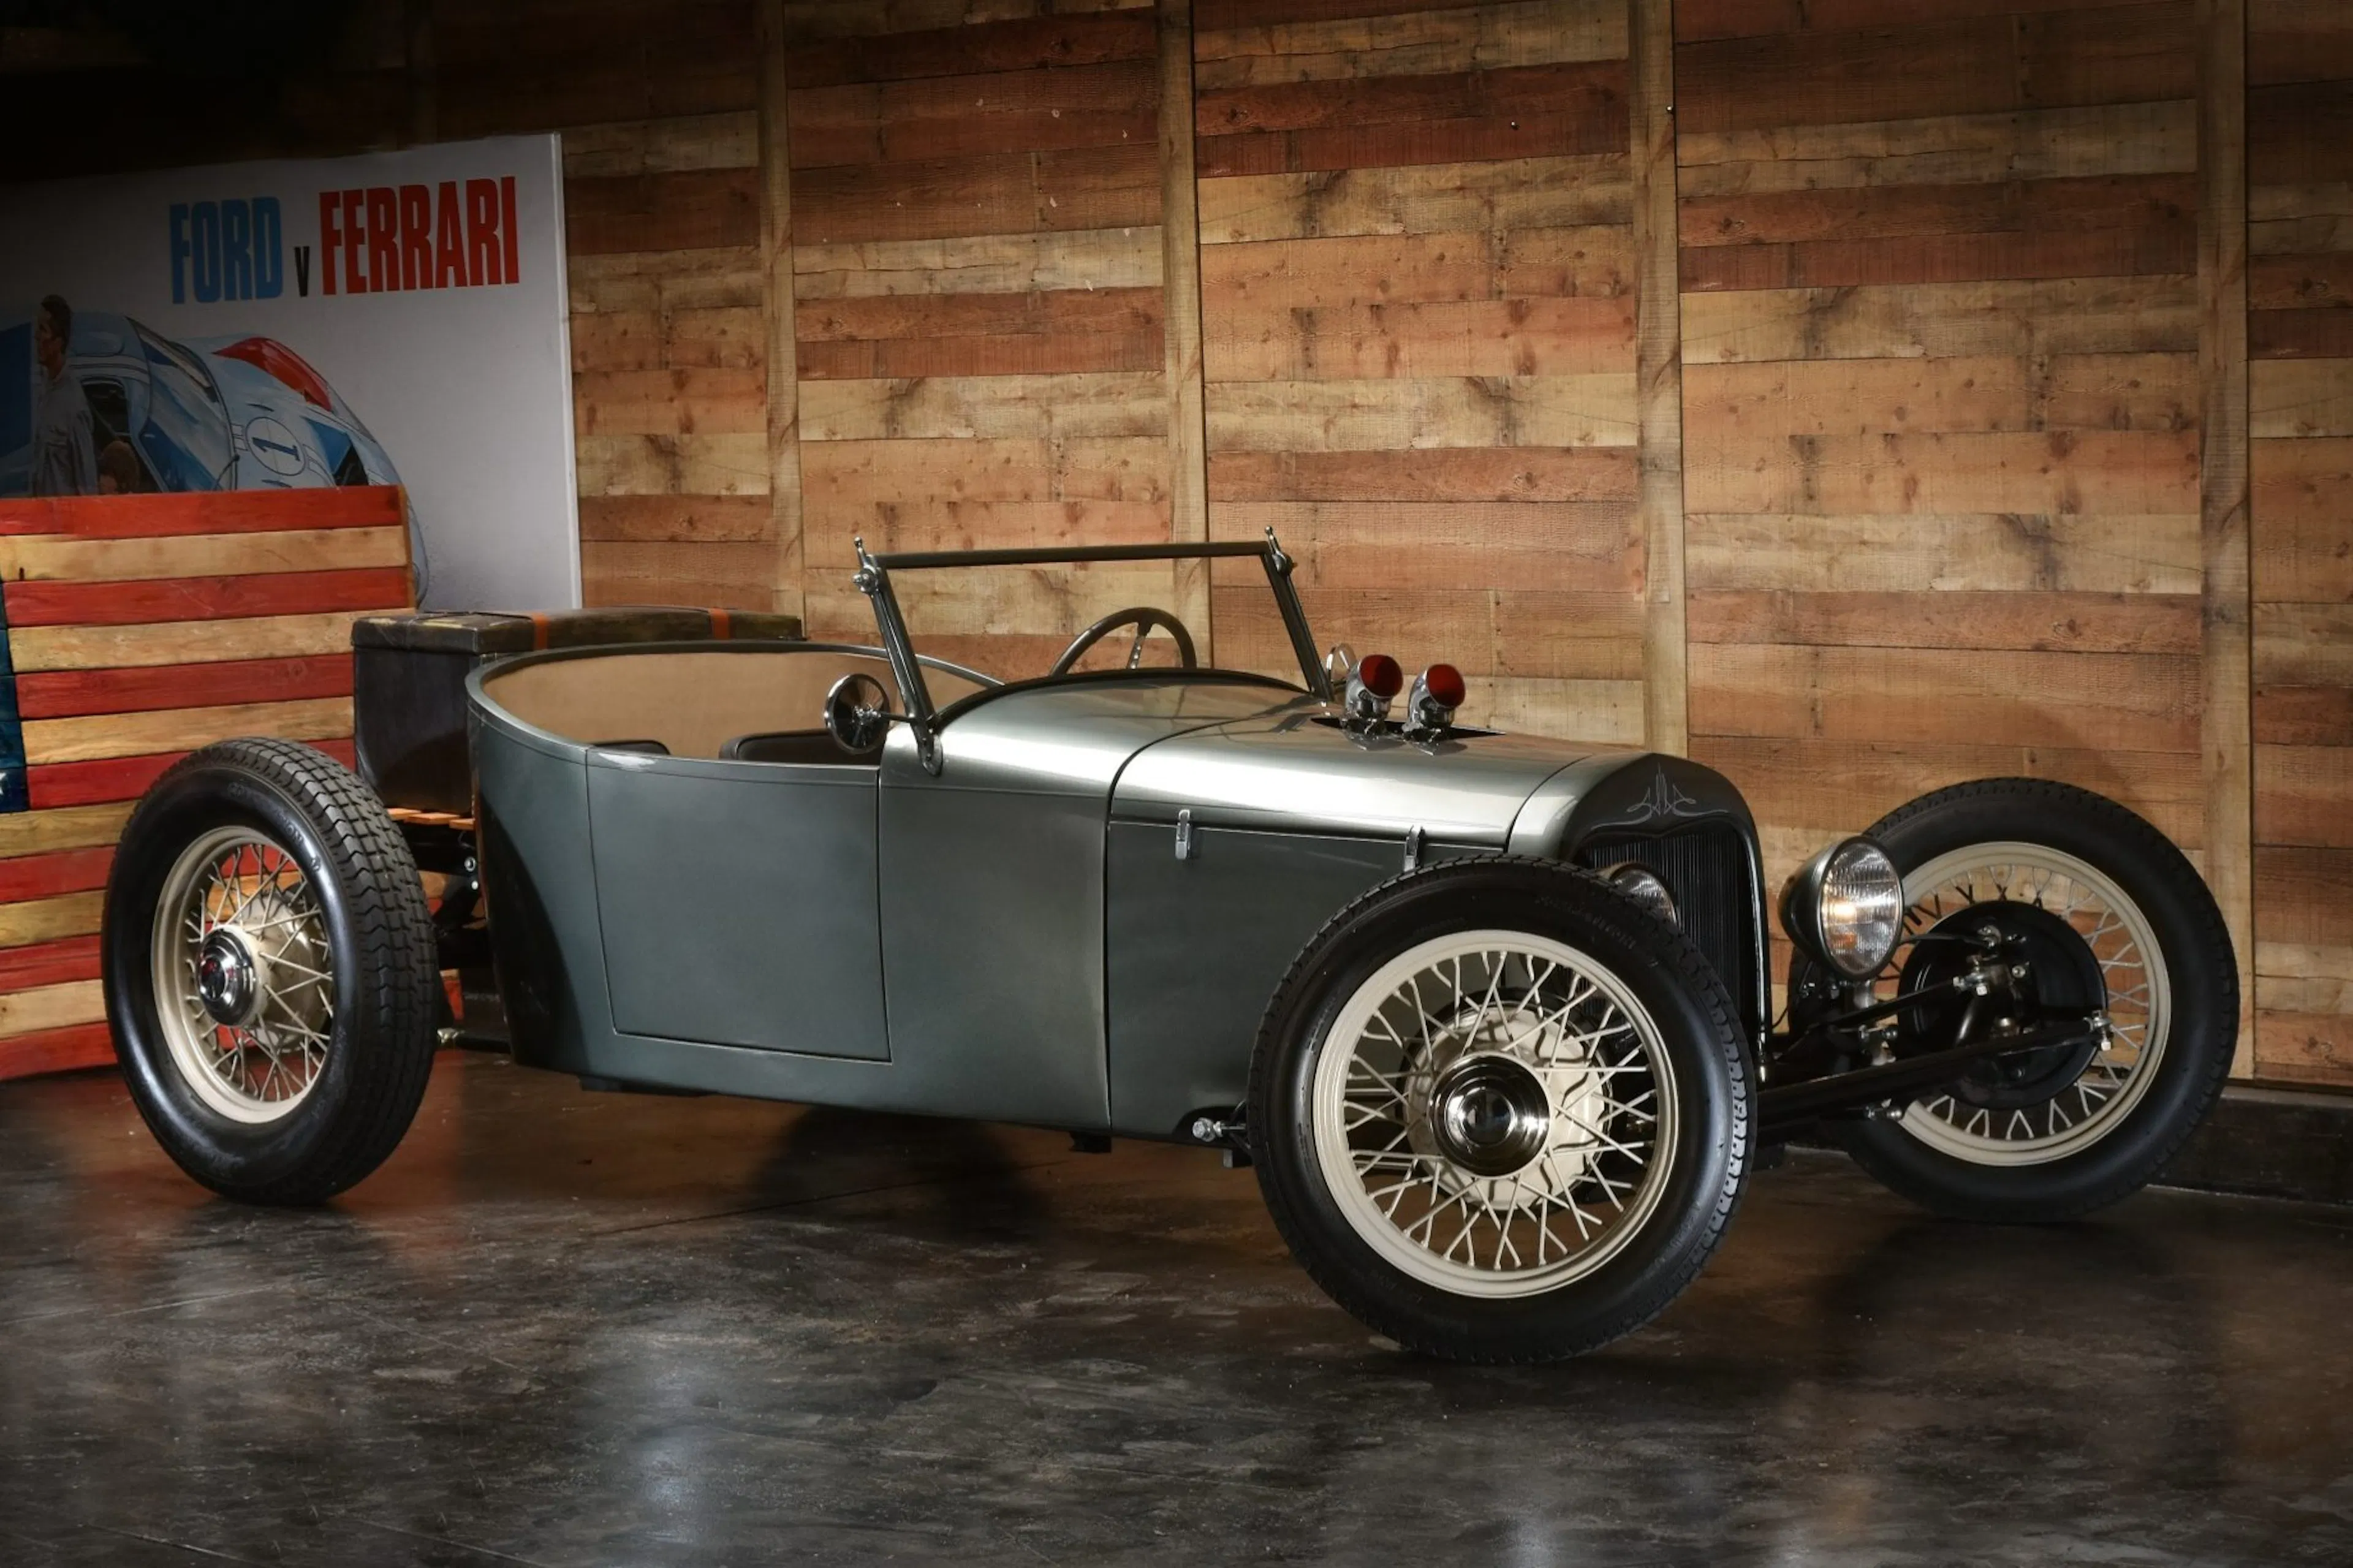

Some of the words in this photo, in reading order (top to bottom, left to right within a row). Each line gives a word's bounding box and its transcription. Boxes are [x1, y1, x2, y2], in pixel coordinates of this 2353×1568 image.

[170, 197, 282, 303] FORD
[320, 176, 518, 295] FERRARI
[251, 437, 300, 461] 1
